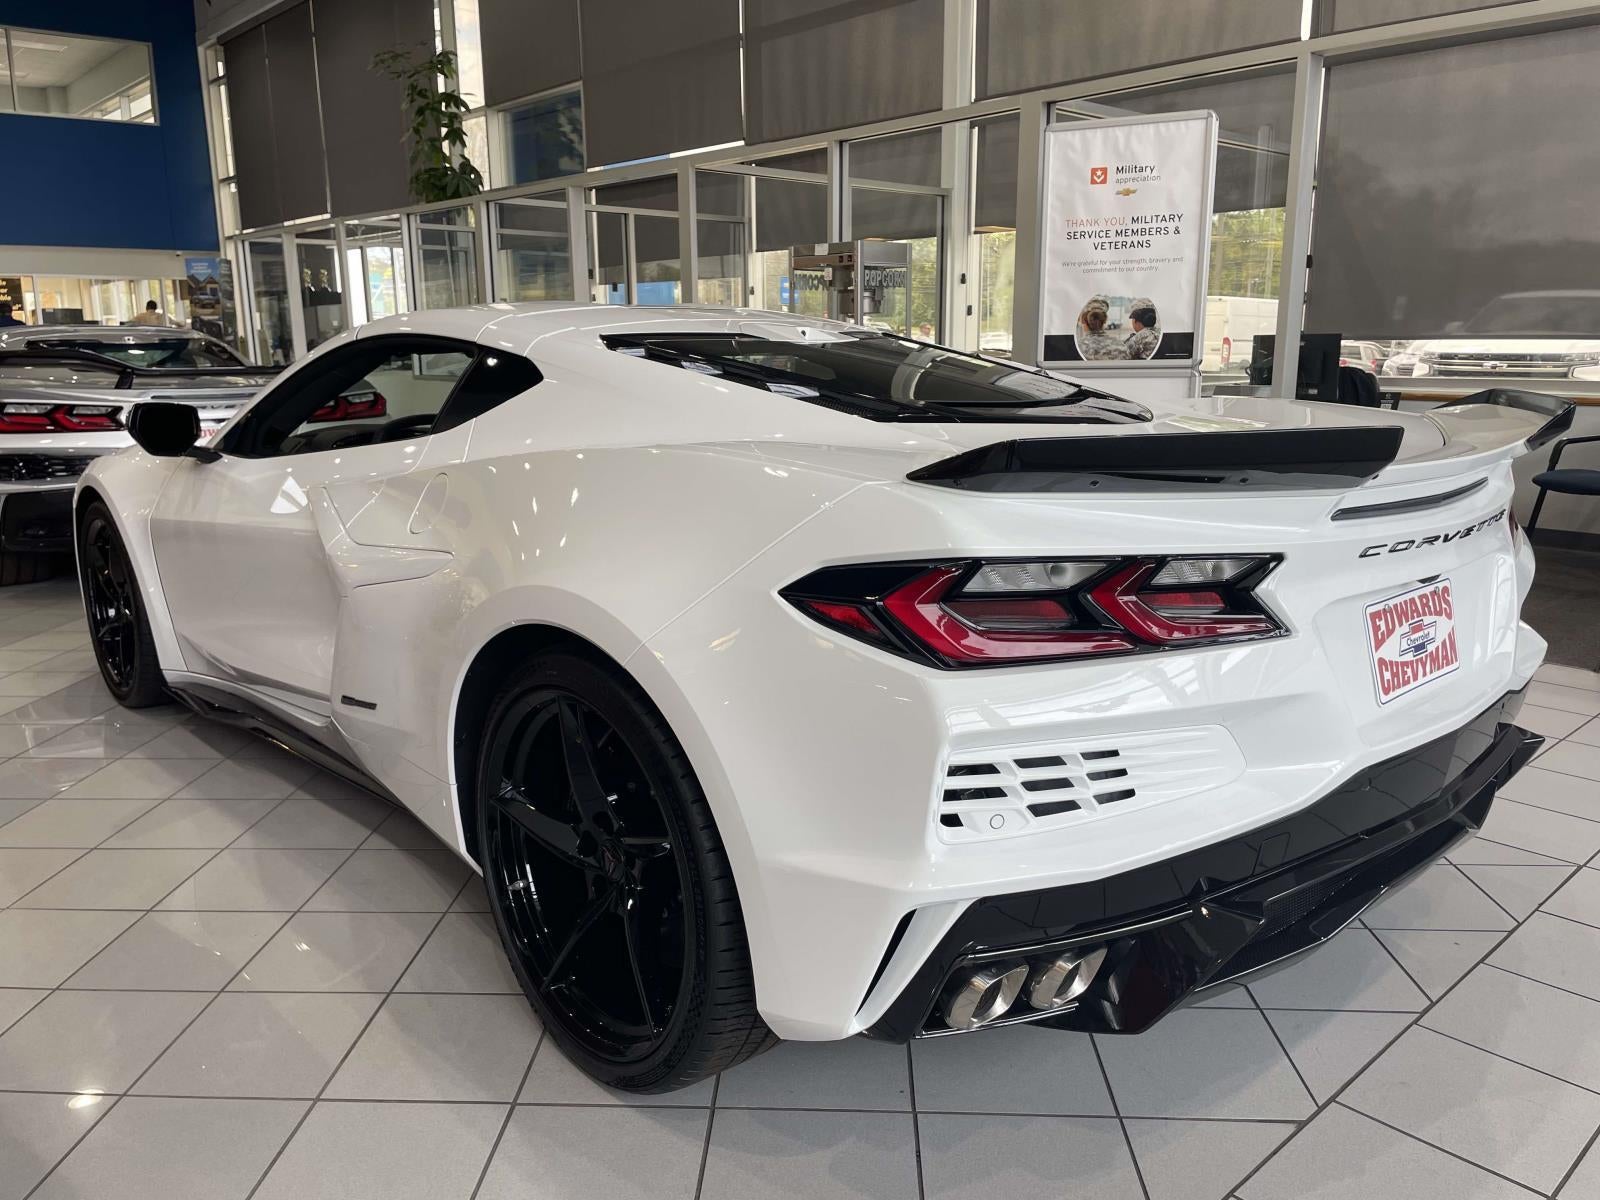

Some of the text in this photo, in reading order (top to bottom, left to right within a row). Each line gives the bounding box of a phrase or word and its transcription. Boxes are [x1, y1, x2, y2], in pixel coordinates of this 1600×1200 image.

[1116, 165, 1155, 175] Military
[1116, 174, 1161, 184] appreciation
[1065, 213, 1184, 228] THANK YOU, MILITARY
[1067, 225, 1181, 240] SERVICE MEMBERS &
[1093, 239, 1151, 250] VETERANS
[864, 269, 906, 288] POPCORN
[1358, 508, 1506, 558] CORVETTE
[1369, 585, 1453, 654] EDWARDS
[1407, 631, 1430, 646] Chevrolet
[1377, 626, 1458, 696] CHEVYMAN
